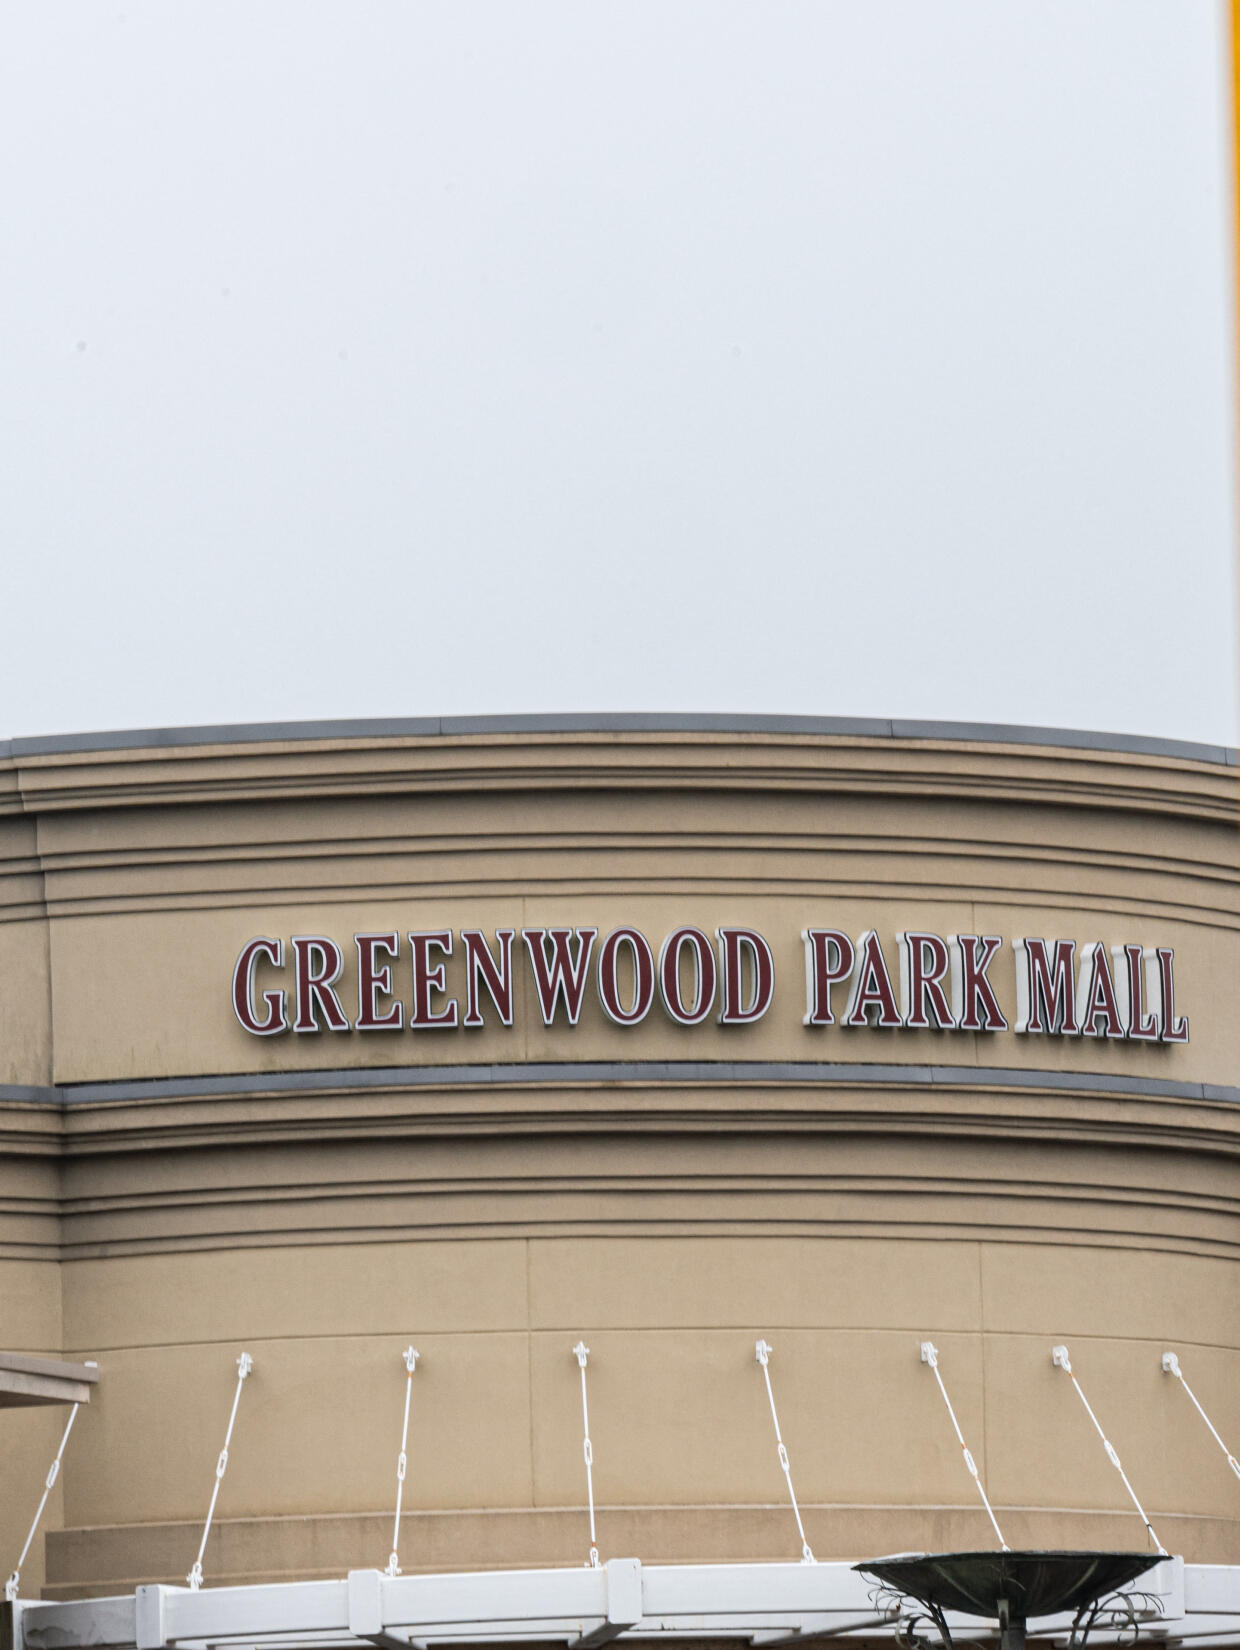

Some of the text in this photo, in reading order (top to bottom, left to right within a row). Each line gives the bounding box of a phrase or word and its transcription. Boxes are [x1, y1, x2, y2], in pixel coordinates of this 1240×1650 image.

[231, 924, 1191, 1046] GREENWOOD PARK MALL
